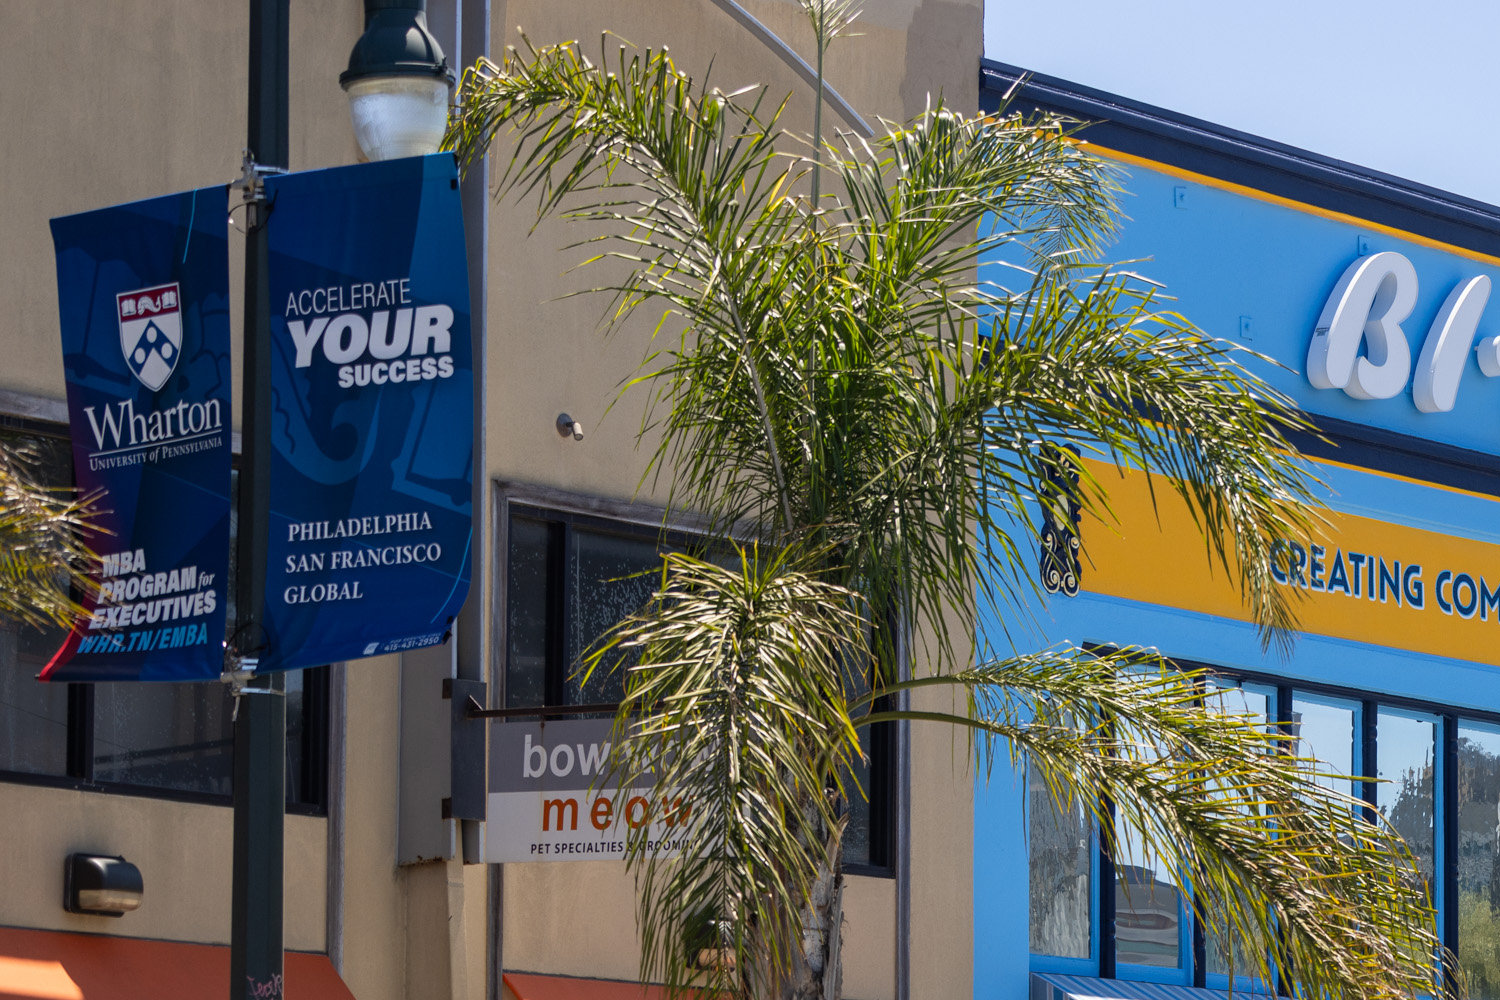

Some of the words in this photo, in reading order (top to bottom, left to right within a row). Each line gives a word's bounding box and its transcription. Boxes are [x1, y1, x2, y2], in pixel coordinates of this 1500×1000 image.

[285, 278, 412, 317] ACCELERATE
[287, 304, 454, 368] YOUR
[337, 356, 454, 389] SUCCESS
[83, 398, 223, 450] Wharton
[89, 452, 147, 471] UNIVERSITY
[149, 446, 161, 464] of
[162, 436, 222, 459] PENNSYLVANIA
[288, 511, 433, 542] PHILADELPHIA
[102, 548, 146, 577] MBA
[285, 553, 325, 573] SAN
[330, 542, 441, 570] FRANCISCO
[1268, 537, 1425, 611] CREATING
[97, 566, 197, 604] PROGRAM
[198, 571, 215, 592] for
[284, 581, 363, 605] GLOBAL
[88, 589, 216, 630] EXECUTIVES
[76, 622, 207, 654] WHR.TN/EMBA
[384, 636, 440, 652] 415-431-2950
[523, 734, 612, 778] bow
[530, 843, 551, 855] PET
[555, 841, 623, 854] SPECIALTIES
